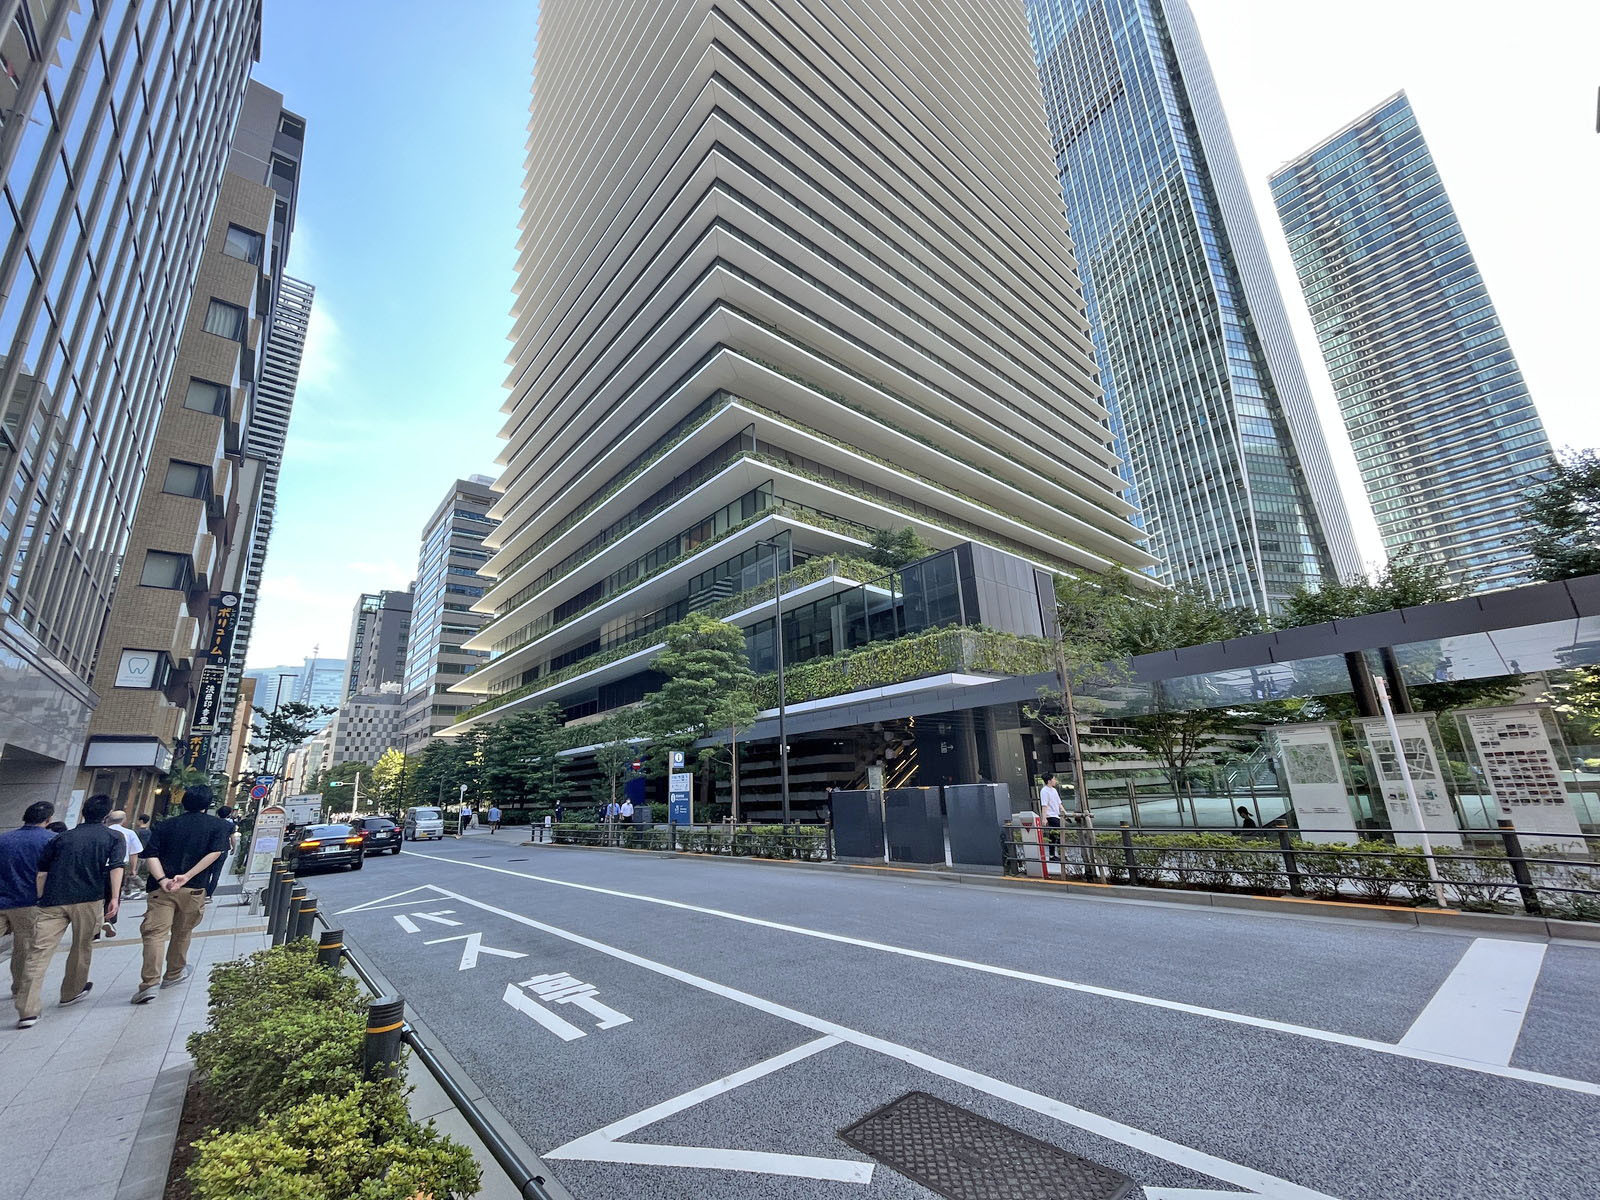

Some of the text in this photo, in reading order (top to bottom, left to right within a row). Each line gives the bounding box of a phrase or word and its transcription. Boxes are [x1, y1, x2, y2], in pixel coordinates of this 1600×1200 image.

[210, 608, 232, 655] ボリューム
[185, 736, 204, 772] ボリューム
[393, 909, 634, 1042] バス停
